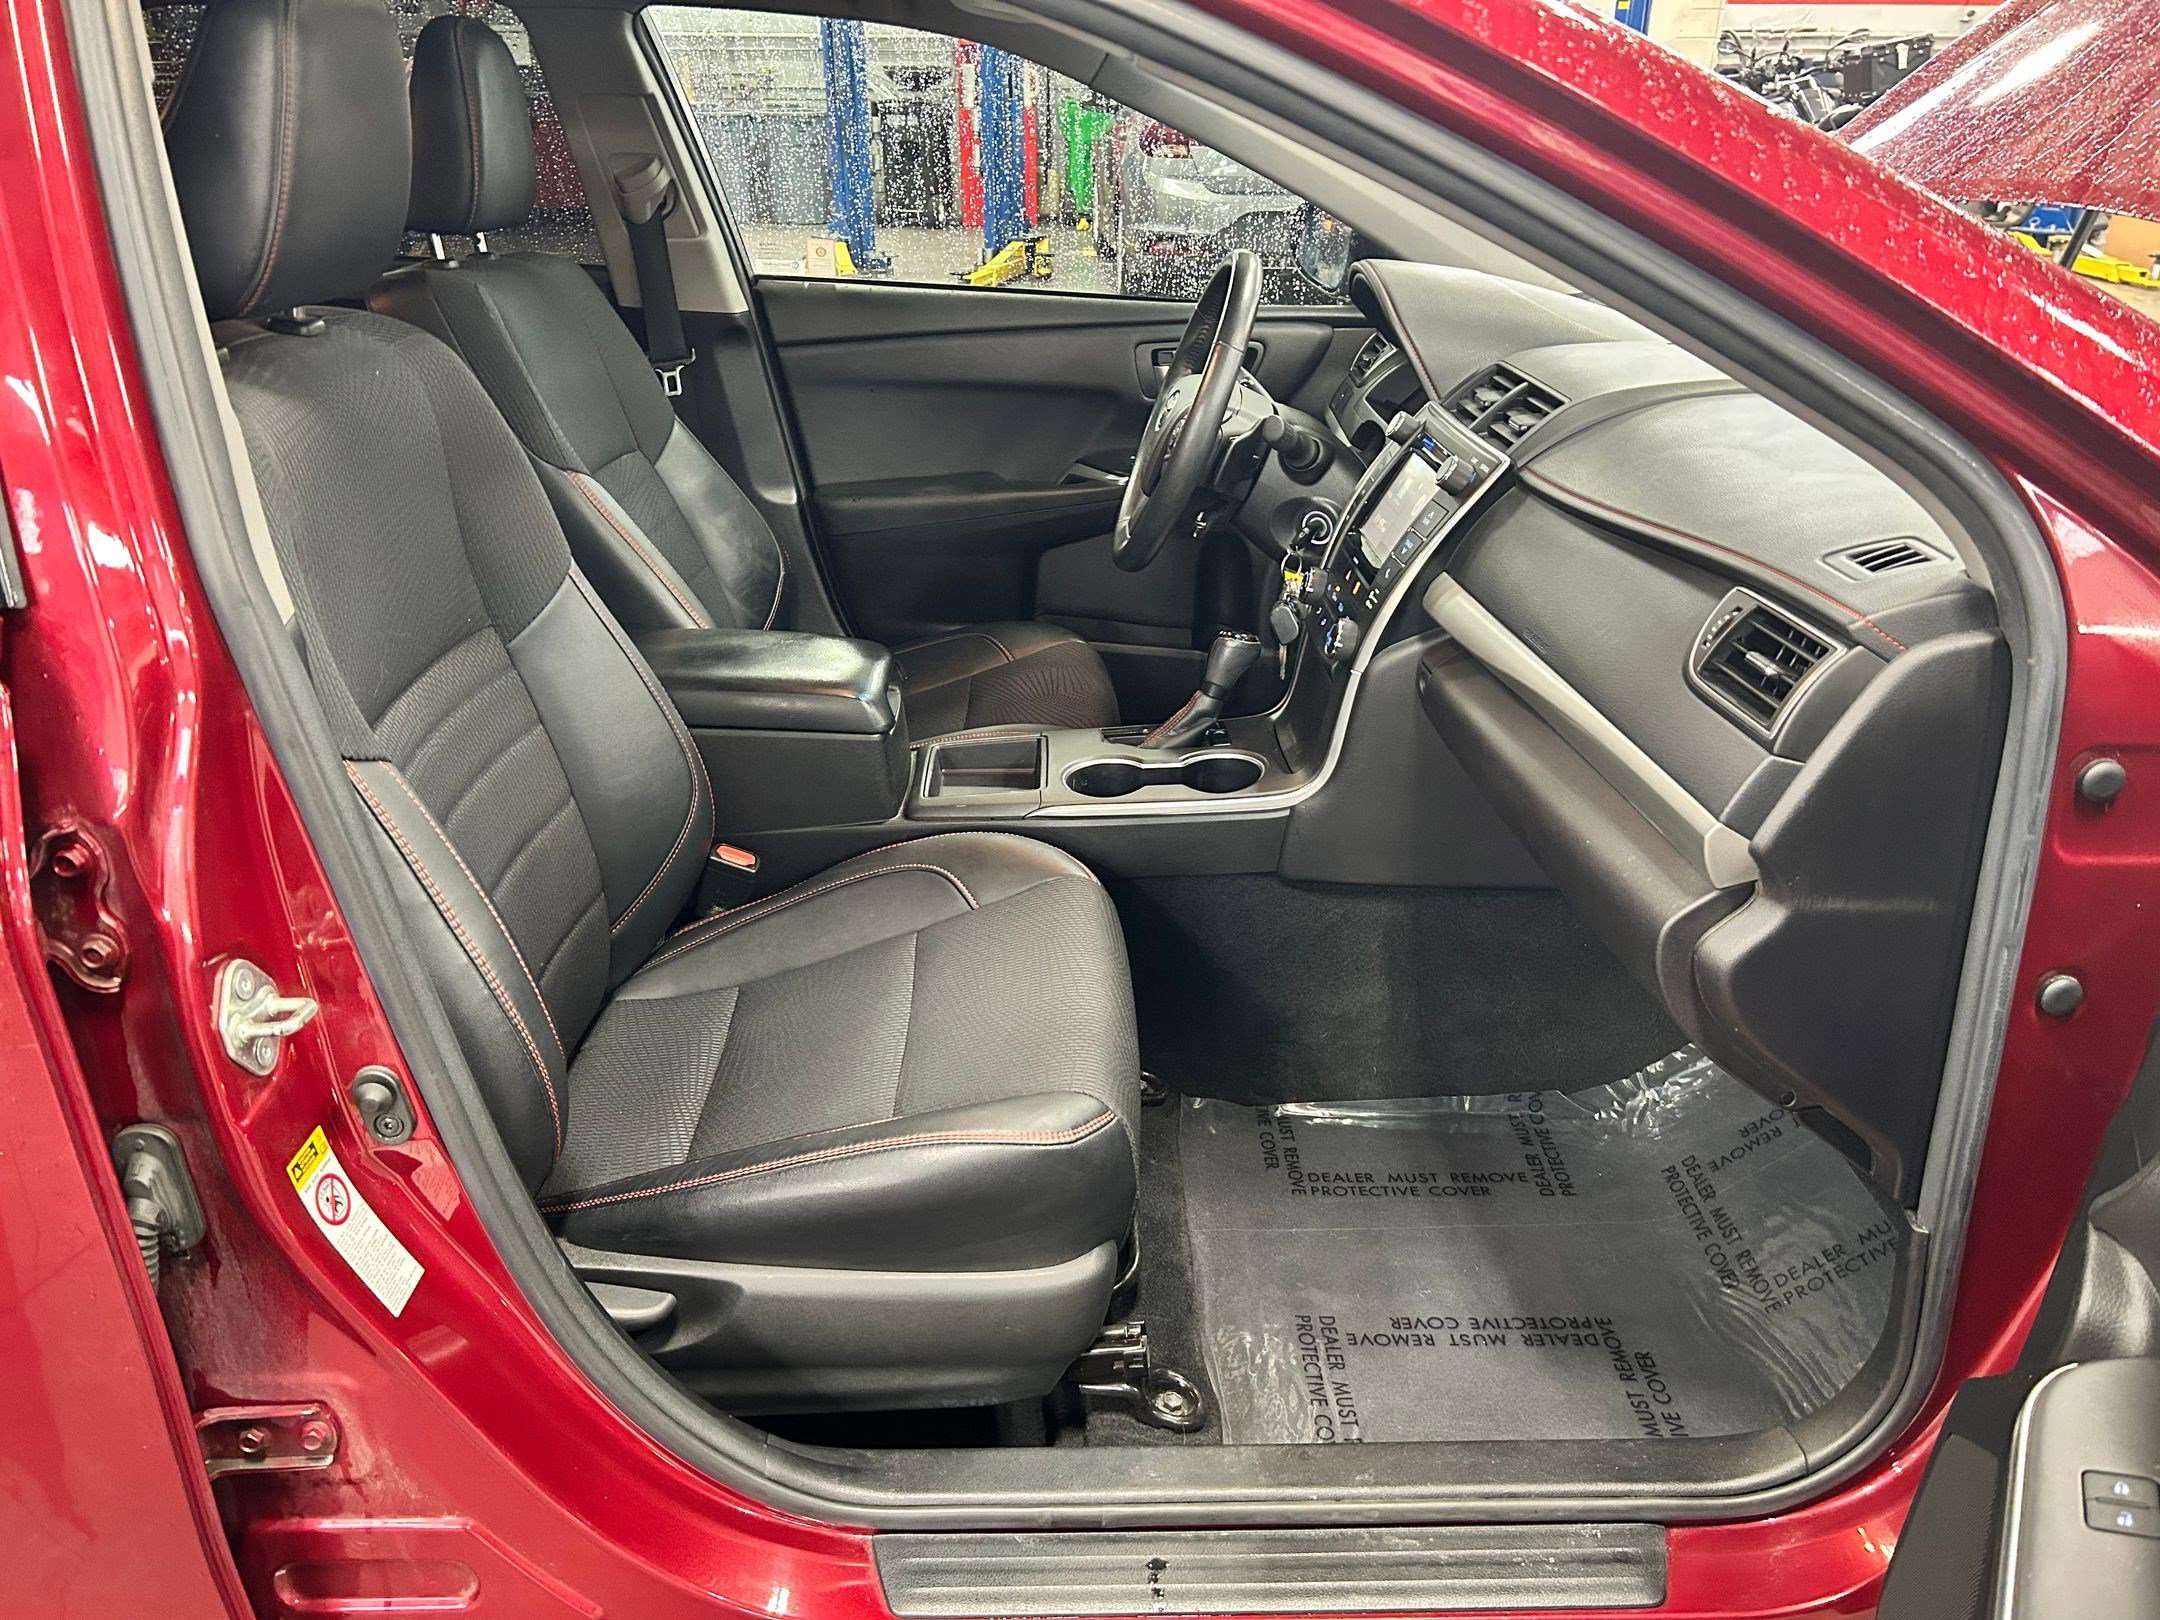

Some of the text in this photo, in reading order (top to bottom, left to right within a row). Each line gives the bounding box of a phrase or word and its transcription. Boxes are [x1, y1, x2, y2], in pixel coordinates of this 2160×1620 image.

[1259, 1132, 1279, 1170] COVER
[1282, 1147, 1306, 1195] REMOVE
[1534, 1128, 1577, 1197] PROTECTIVE
[1707, 1125, 1783, 1173] REMOVE
[1307, 1172, 1528, 1184] DEALER MUST REMOVE
[1310, 1185, 1492, 1197] PROTECTIVE COVER
[1525, 1153, 1555, 1197] DEALER
[1660, 1164, 1713, 1241] PROTECTIVE
[1681, 1154, 1783, 1314] DEALER MUST REMOVE
[1773, 1243, 1849, 1289] DEALER
[1346, 1332, 1600, 1347] DEALER MUST REMOVE
[1388, 1316, 1593, 1330] PROTECTIVE COVER
[1294, 1314, 1336, 1442] PROTECTIVE CO
[1318, 1315, 1346, 1371] DEALER
[1332, 1381, 1360, 1427] MUST
[1593, 1317, 1664, 1438] MUST REMOVE
[1634, 1351, 1672, 1405] COVER
